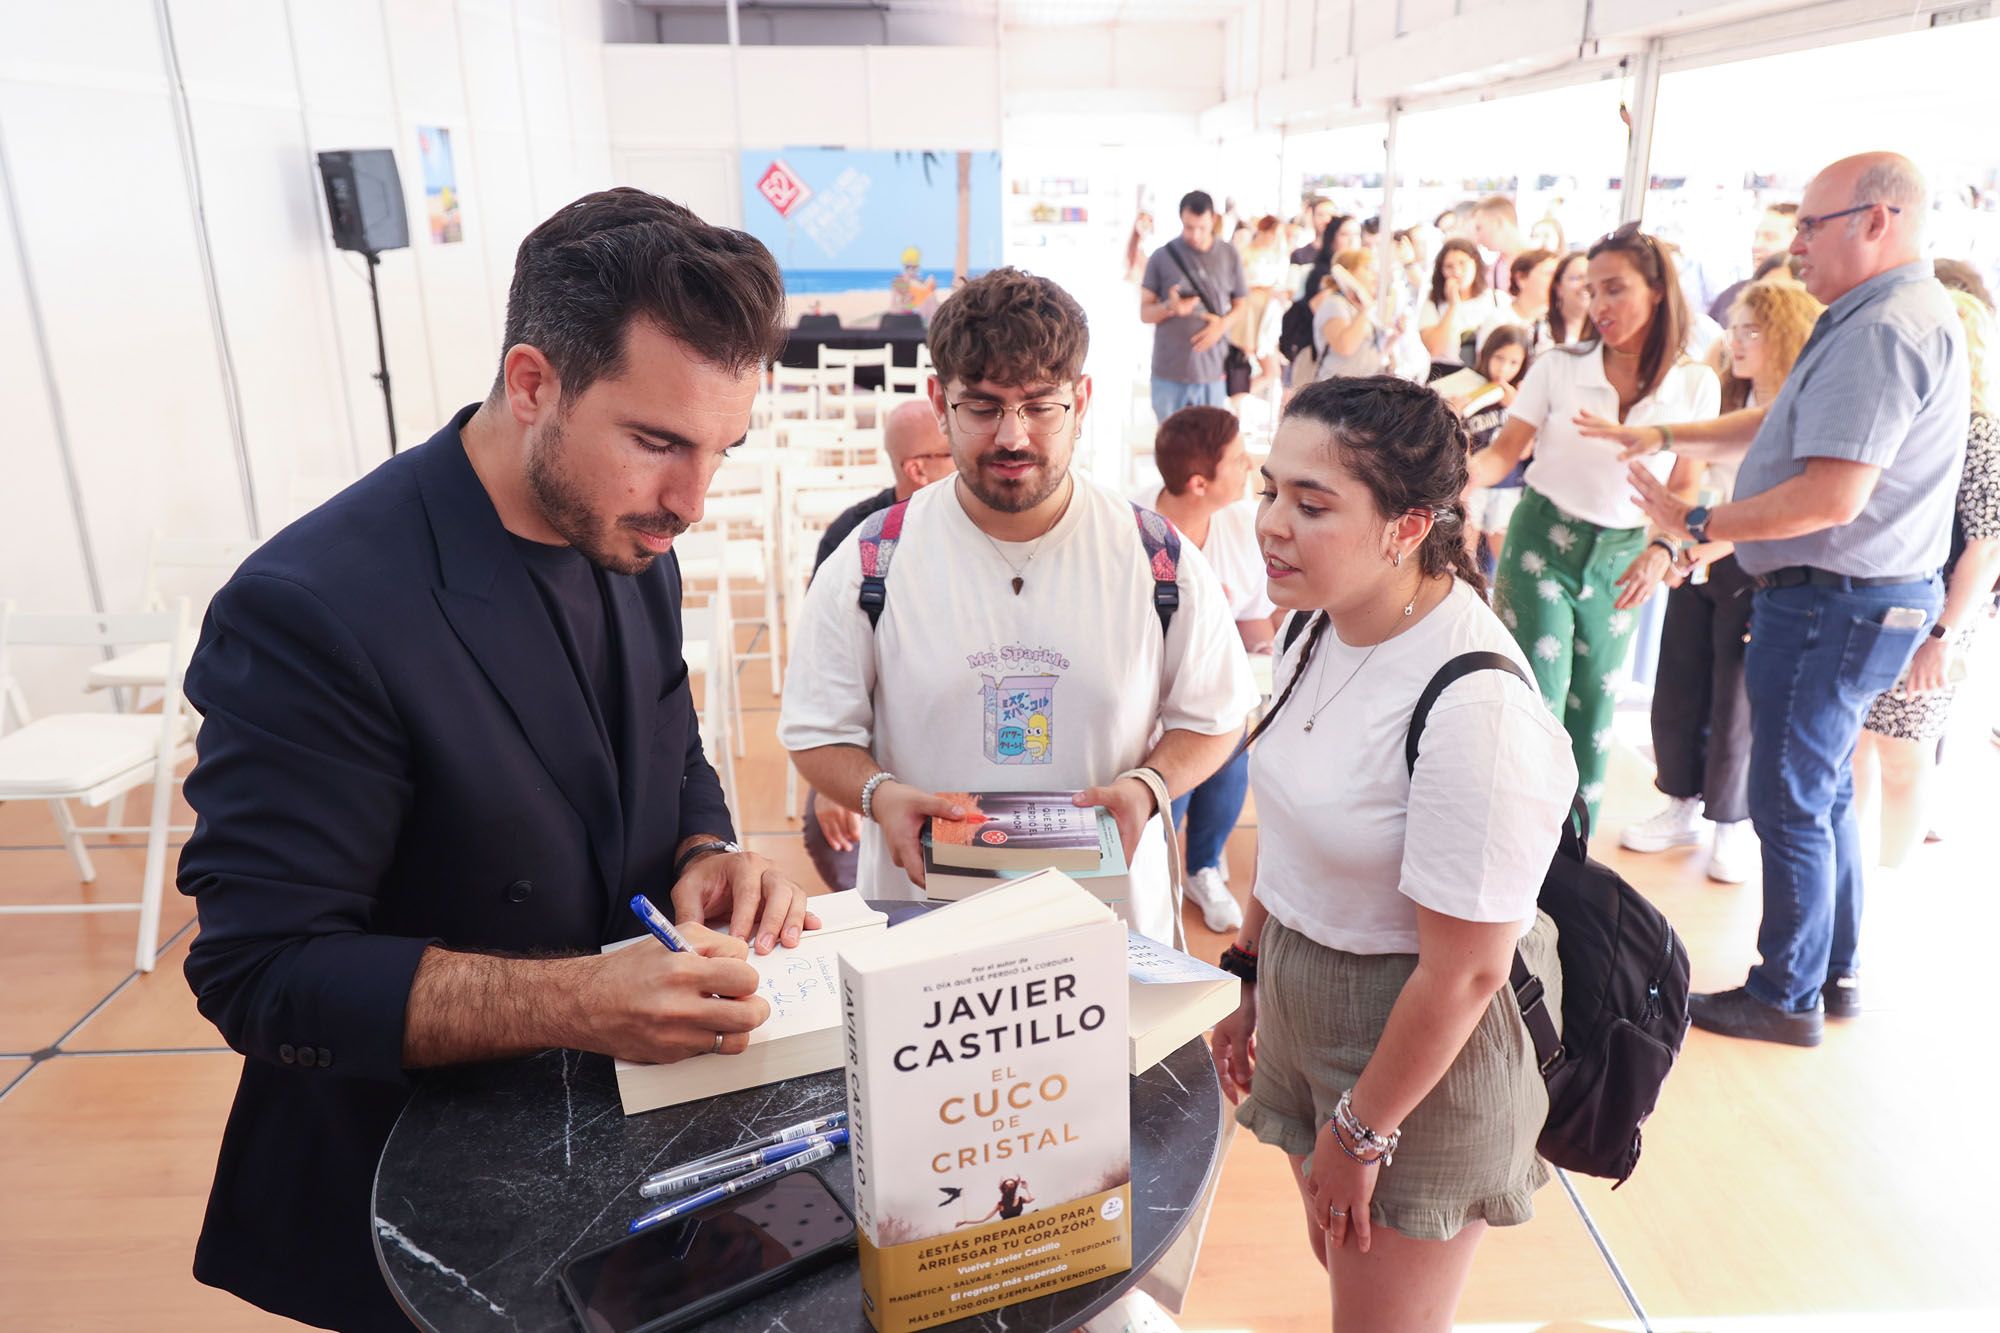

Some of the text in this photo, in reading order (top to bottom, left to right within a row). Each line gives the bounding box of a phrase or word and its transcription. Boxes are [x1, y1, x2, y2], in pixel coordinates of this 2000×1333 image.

[967, 646, 1070, 669] Mr. Sparkle
[1014, 810, 1022, 830] AMOR
[1043, 807, 1052, 832] QUE SE
[923, 985, 933, 993] EL
[954, 977, 972, 987] QUE
[975, 974, 985, 983] SE
[1021, 965, 1033, 974] LA
[1034, 956, 1075, 971] CORDURA
[971, 965, 985, 973] Por
[996, 959, 1017, 970] autor
[1019, 957, 1028, 965] de
[923, 973, 1076, 1029] JAVIER
[893, 1004, 1106, 1072] CASTILLO
[844, 979, 866, 1186] JAVIER CASTILLO
[992, 1066, 1016, 1082] EL
[939, 1074, 1069, 1125] CUCO
[992, 1115, 1020, 1132] DE
[931, 1123, 1079, 1174] CRISTAL
[918, 1206, 1094, 1259] ¿ESTÁS PREPARADO PARA
[918, 1217, 1096, 1272] ARRIESGAR TU CORAZÓN?
[889, 1235, 1121, 1303] MAGNÉTICA SALVAJE MONUMENTAL TREPIDANTE
[958, 1242, 1060, 1275] Vuelve Javier Castillo
[909, 1263, 1107, 1324] MÁS DE 1.700.000 EJEMPLARES VENDIDOS
[951, 1263, 1068, 1302] El regreso más esperado
